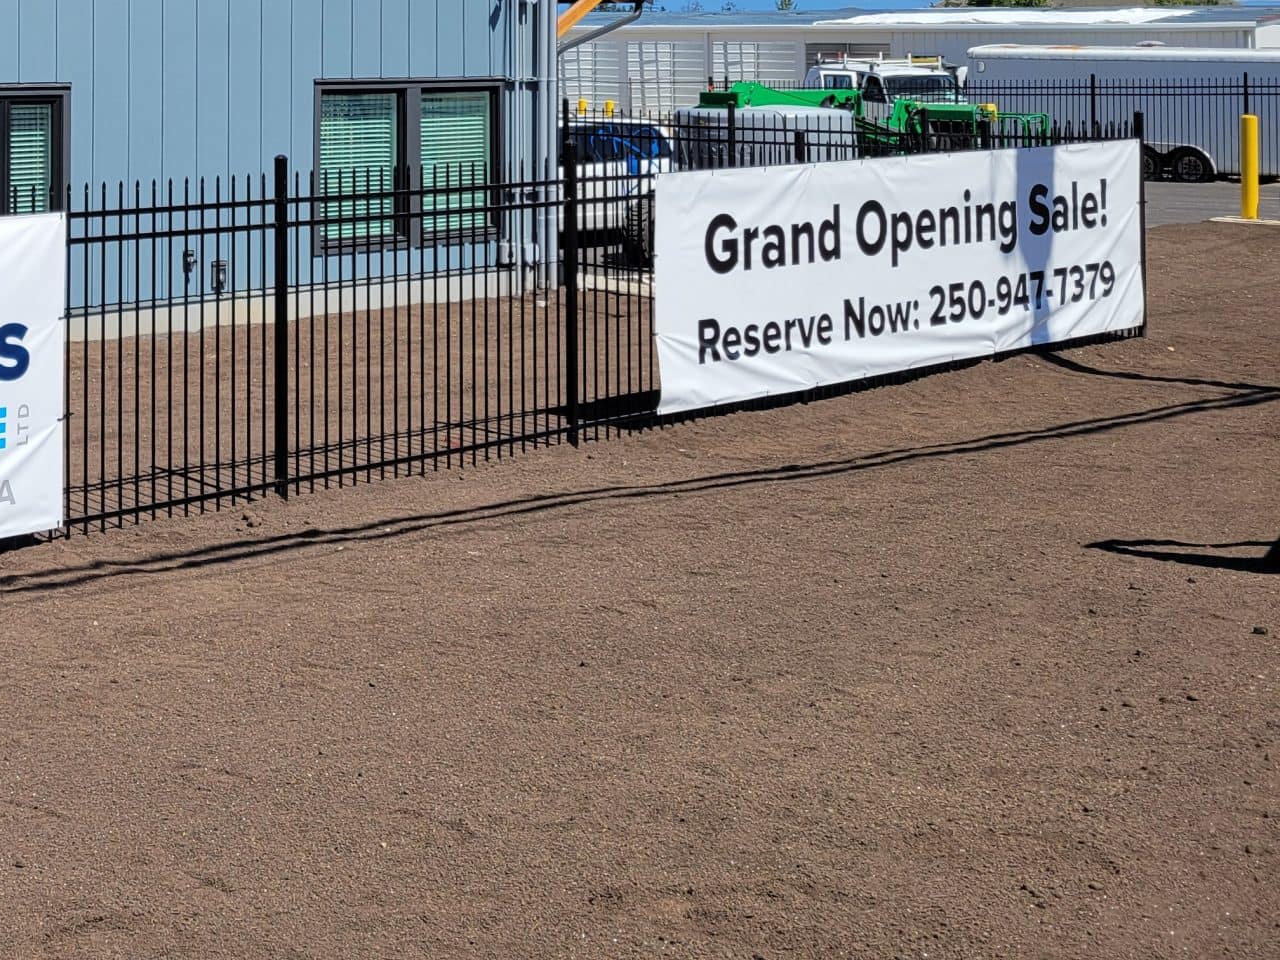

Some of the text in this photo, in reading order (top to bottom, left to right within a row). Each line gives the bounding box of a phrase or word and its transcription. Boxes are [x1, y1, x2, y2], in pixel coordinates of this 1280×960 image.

[704, 178, 1108, 274] Grand Opening Sale!
[698, 260, 1116, 365] Reserve Now: 250-947-7379
[16, 403, 30, 446] LTD
